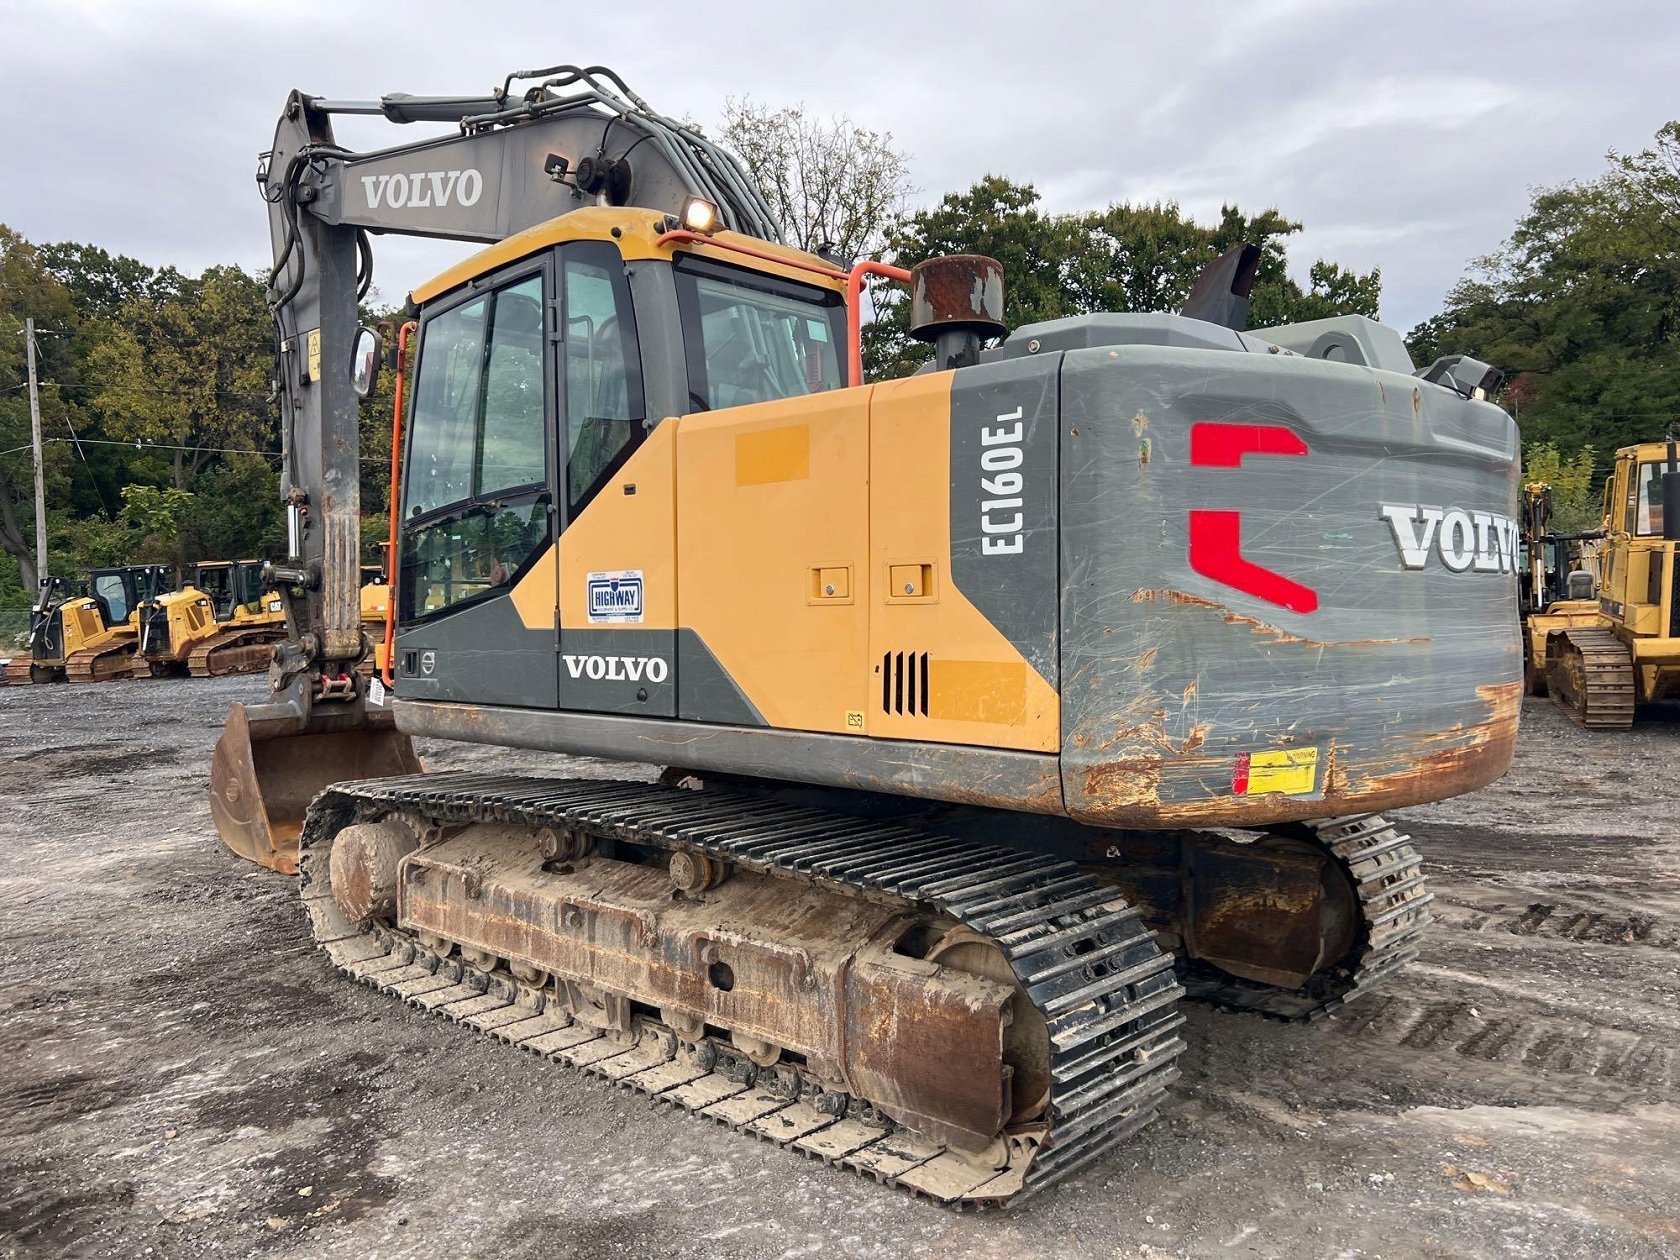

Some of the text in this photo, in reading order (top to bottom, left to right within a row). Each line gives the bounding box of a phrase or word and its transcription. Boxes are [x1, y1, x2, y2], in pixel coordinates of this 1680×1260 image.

[361, 169, 482, 208] VOLVO
[981, 406, 1023, 555] EC160EL
[1380, 502, 1519, 575] VOLVO
[270, 601, 281, 611] CAT
[595, 590, 636, 606] HIGHWAY
[562, 655, 668, 683] VOLVO
